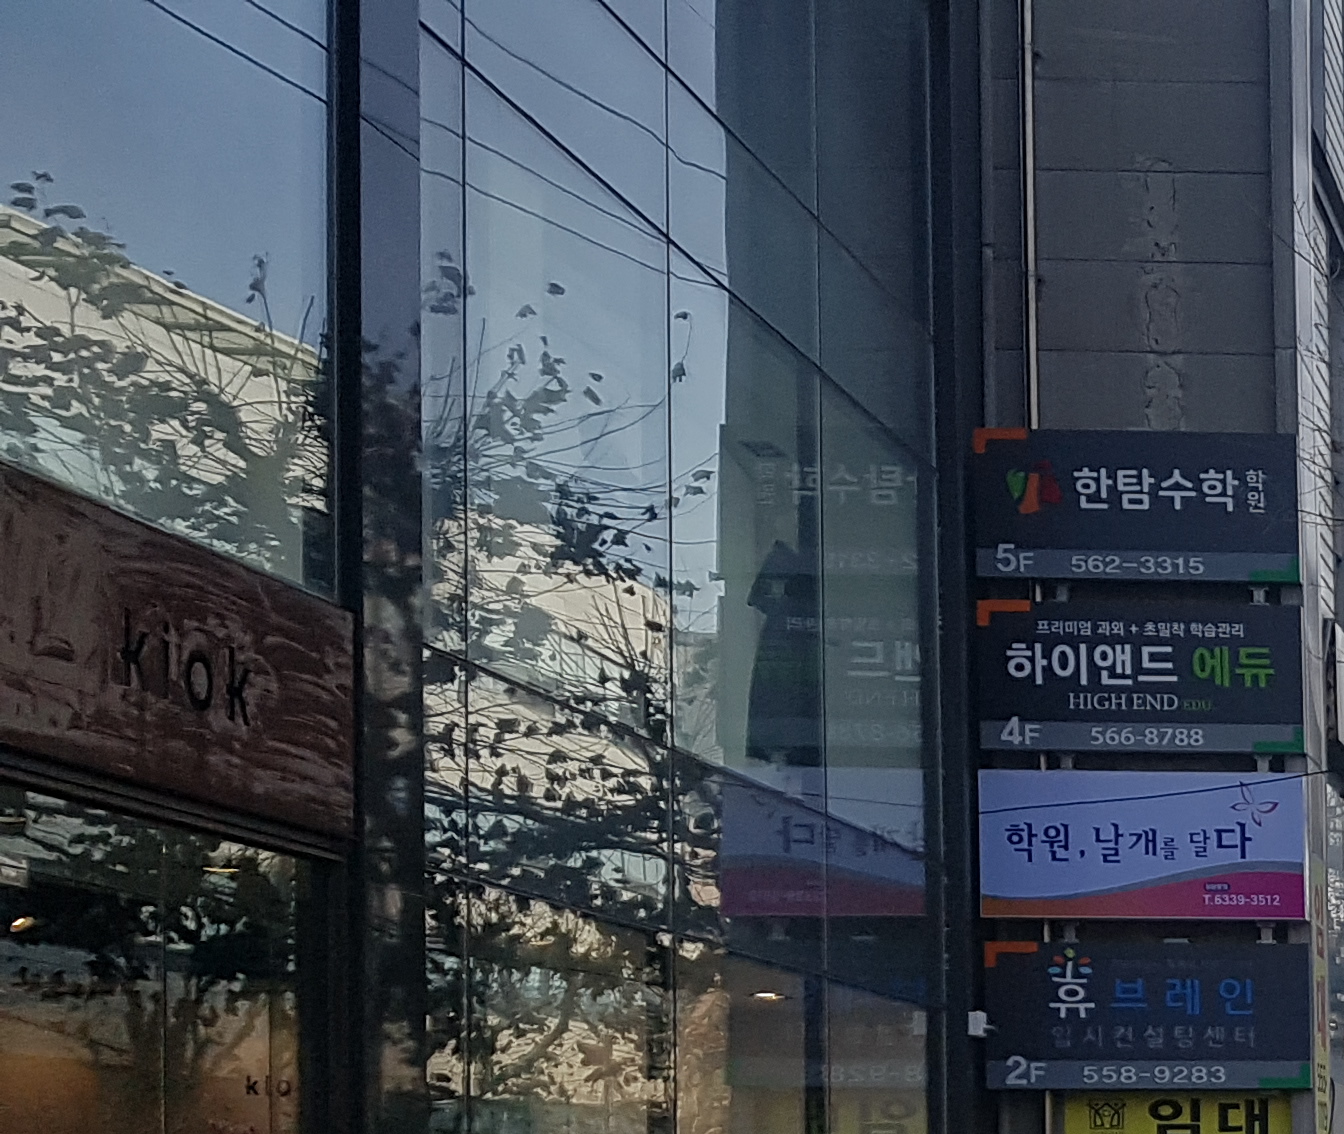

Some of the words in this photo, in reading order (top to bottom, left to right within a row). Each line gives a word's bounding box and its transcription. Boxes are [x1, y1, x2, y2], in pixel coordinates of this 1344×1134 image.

[1073, 467, 1238, 512] 한탐수학
[1245, 469, 1267, 513] 학원
[995, 543, 1034, 572] 5F
[1071, 556, 1204, 575] 562-3315
[1036, 621, 1092, 635] 프리미엄
[1097, 621, 1123, 636] 과외
[1143, 622, 1185, 637] 초밀착
[1190, 622, 1244, 637] 학습관리
[1006, 642, 1178, 686] 하이앤드
[1192, 646, 1275, 687] 에듀
[1068, 692, 1130, 710] HIGH
[1132, 693, 1178, 711] END
[1000, 716, 1041, 745] 4F
[1090, 727, 1204, 746] 566-8788
[1093, 822, 1179, 863] 날개를
[1188, 821, 1252, 860] 달다
[1203, 894, 1281, 906] T.6339-3512
[1006, 1056, 1046, 1085] 2F
[1083, 1066, 1226, 1083] 558-9283
